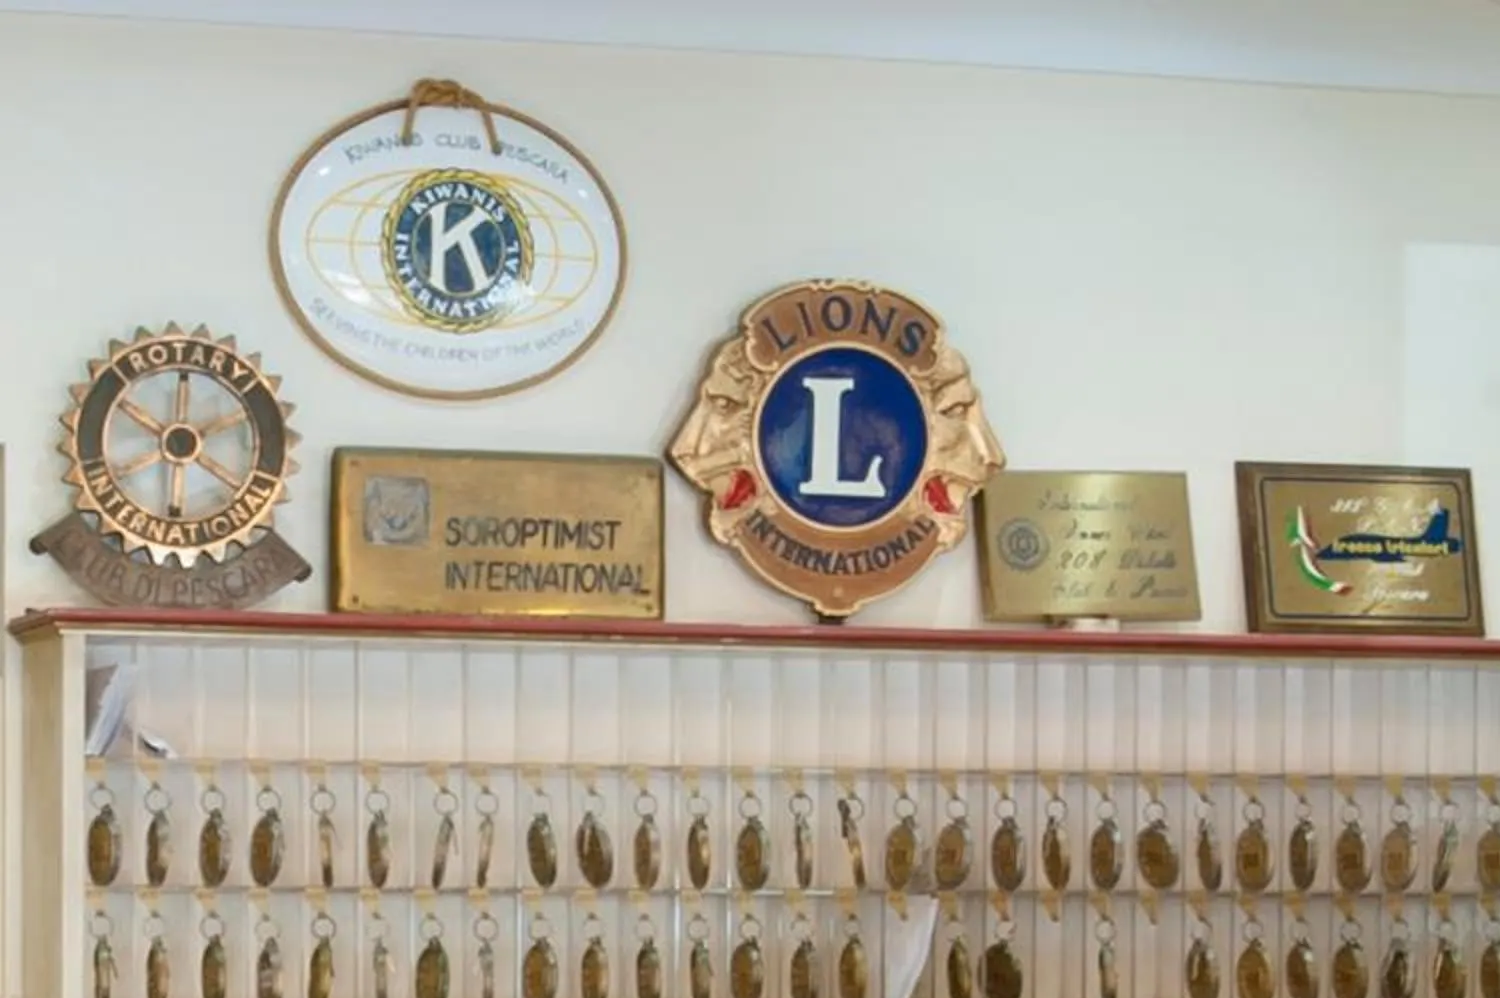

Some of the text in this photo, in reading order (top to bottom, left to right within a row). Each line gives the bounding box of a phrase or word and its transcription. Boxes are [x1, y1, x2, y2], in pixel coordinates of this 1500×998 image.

[344, 132, 422, 164] KIWANS
[434, 133, 481, 150] CLUB
[410, 183, 505, 222] KIWANIS
[428, 200, 494, 294] K
[762, 295, 927, 357] LIONS
[128, 342, 250, 381] ROTARY
[799, 376, 887, 498] L
[86, 464, 273, 546] INTERNATIONAL
[445, 517, 622, 550] SOROPTIMIST
[746, 509, 936, 575] INTERNATIONAL
[444, 560, 652, 595] INTERNATIONAL
